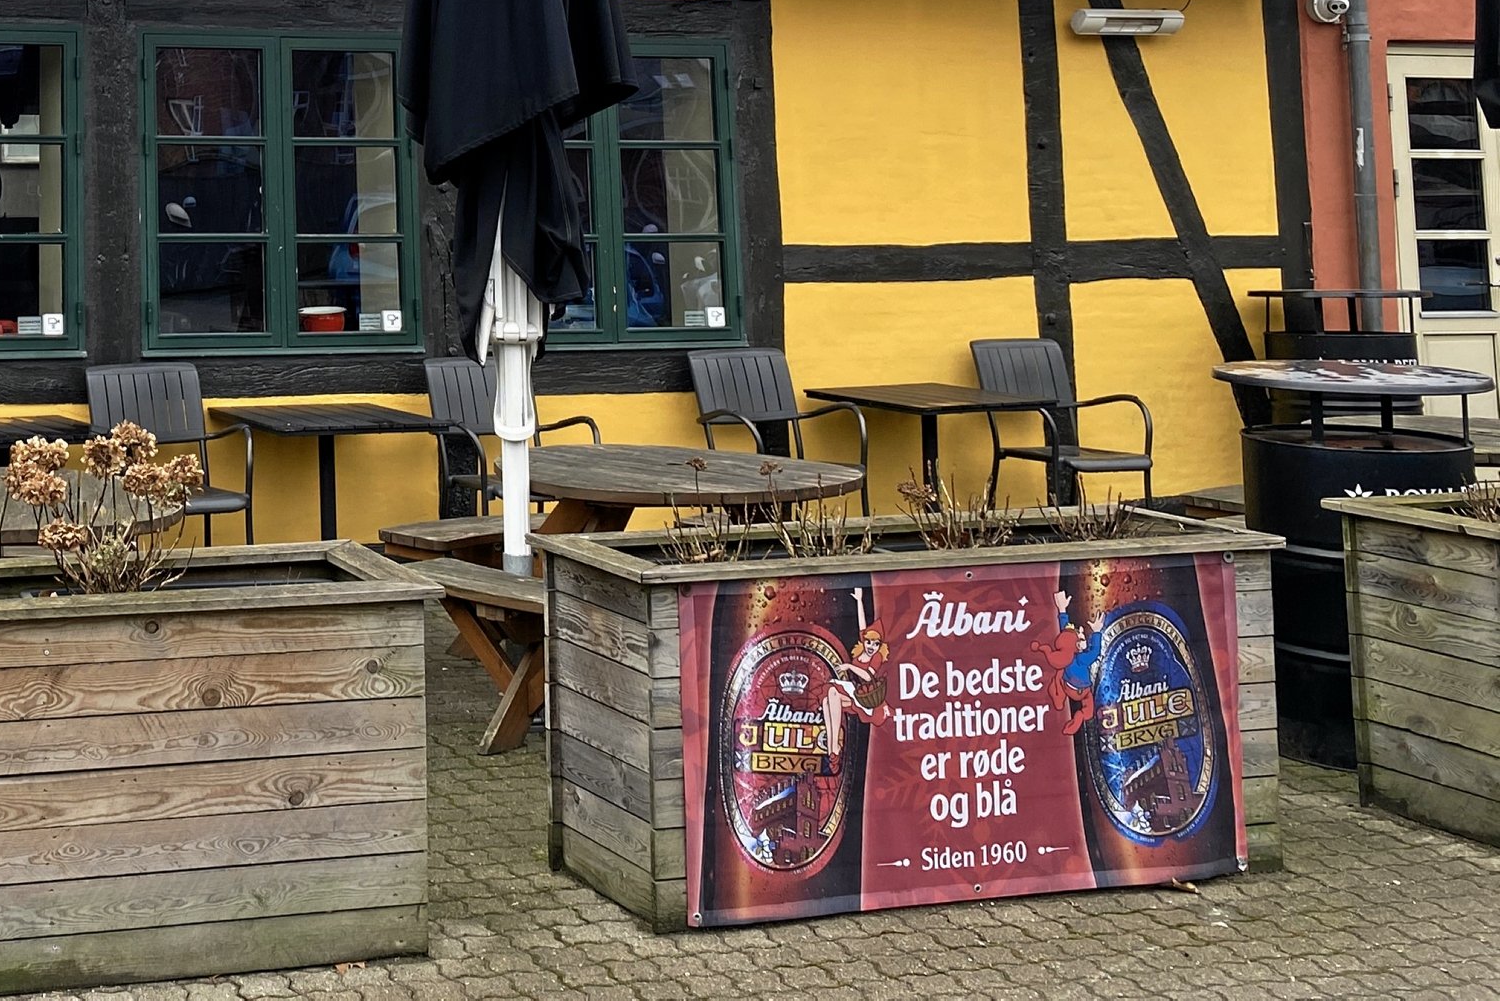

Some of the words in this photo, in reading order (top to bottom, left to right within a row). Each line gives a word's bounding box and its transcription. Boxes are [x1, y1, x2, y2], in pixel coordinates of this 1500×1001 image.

[906, 594, 1031, 639] Albani
[899, 662, 940, 700] De
[946, 658, 1043, 697] bedste
[1116, 676, 1169, 703] Albani
[758, 699, 824, 724] Albani
[894, 700, 1049, 742] traditioner
[1119, 723, 1175, 748] BRYG
[756, 755, 819, 773] BRYG
[920, 751, 951, 781] er
[959, 739, 1025, 779] røde
[930, 793, 969, 828] og
[976, 779, 1017, 818] blå
[921, 847, 975, 871] Siden
[980, 840, 1027, 865] 1960
